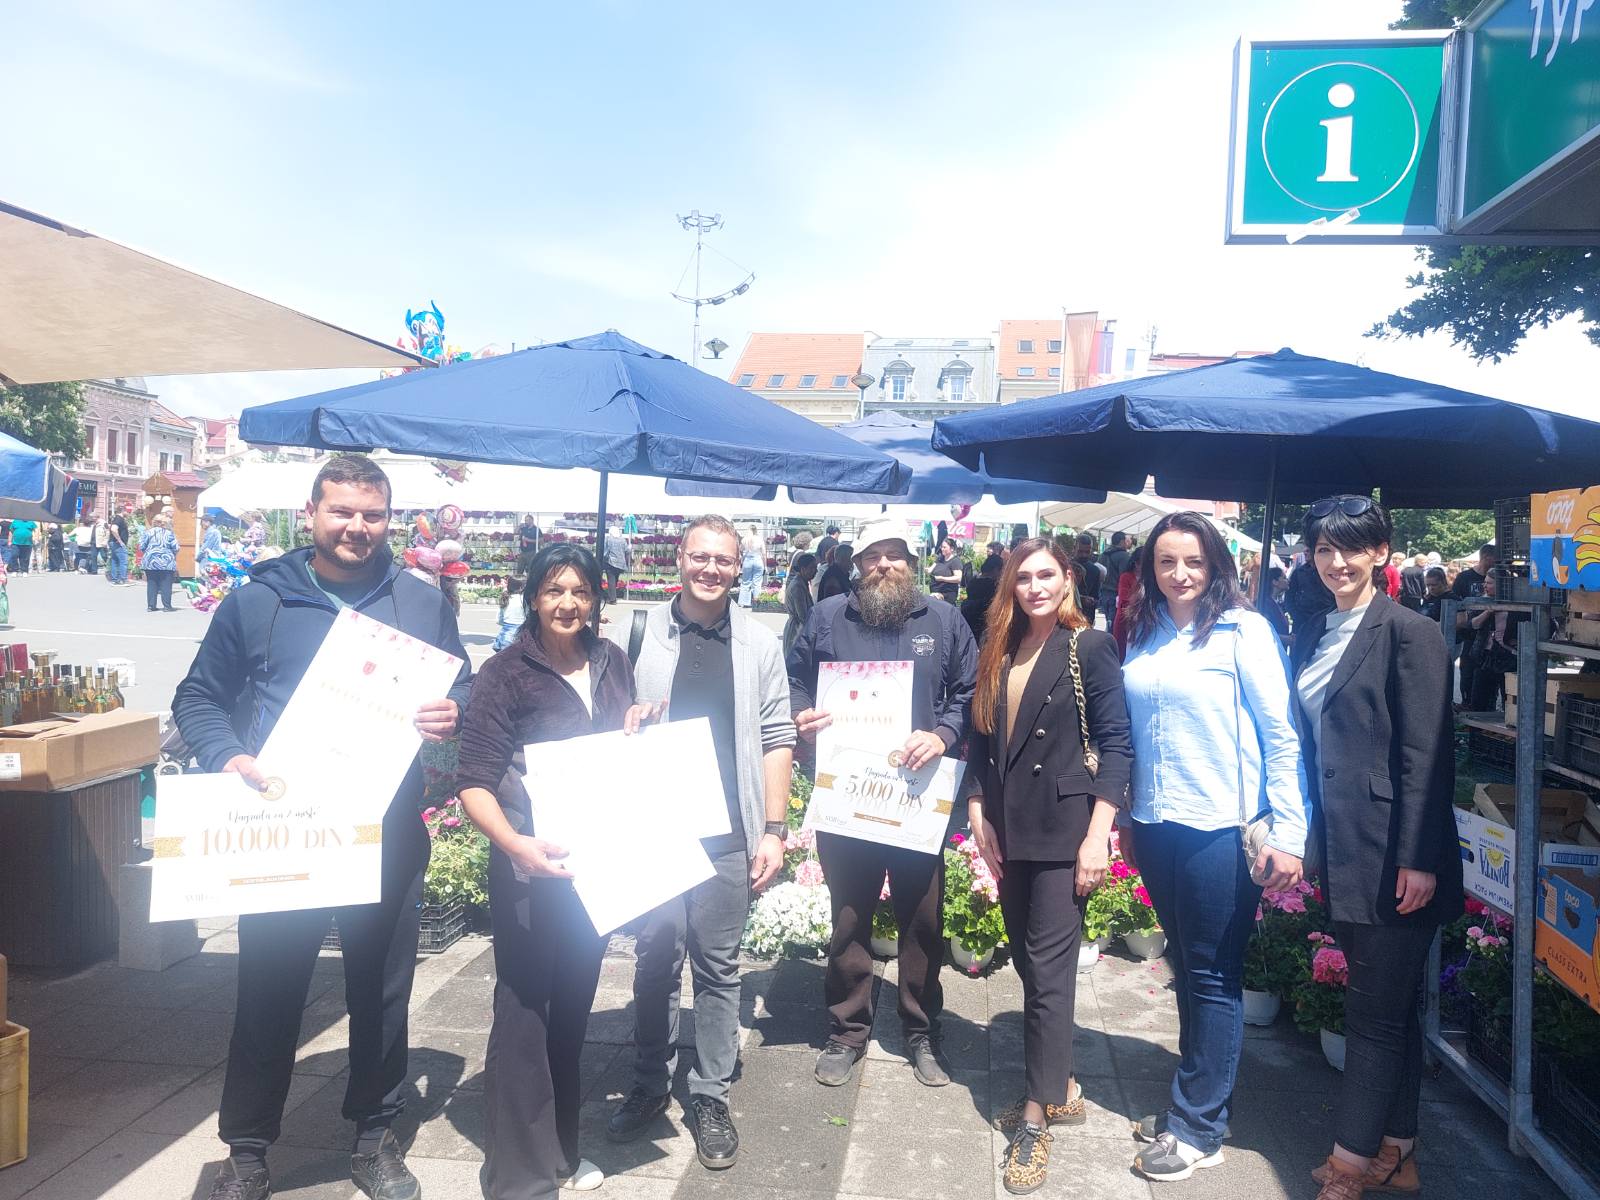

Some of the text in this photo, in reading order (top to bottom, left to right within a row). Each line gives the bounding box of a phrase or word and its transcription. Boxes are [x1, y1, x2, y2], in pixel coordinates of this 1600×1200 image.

[202, 823, 290, 856] 10.000
[1547, 946, 1587, 984] CLASS EXTRA
